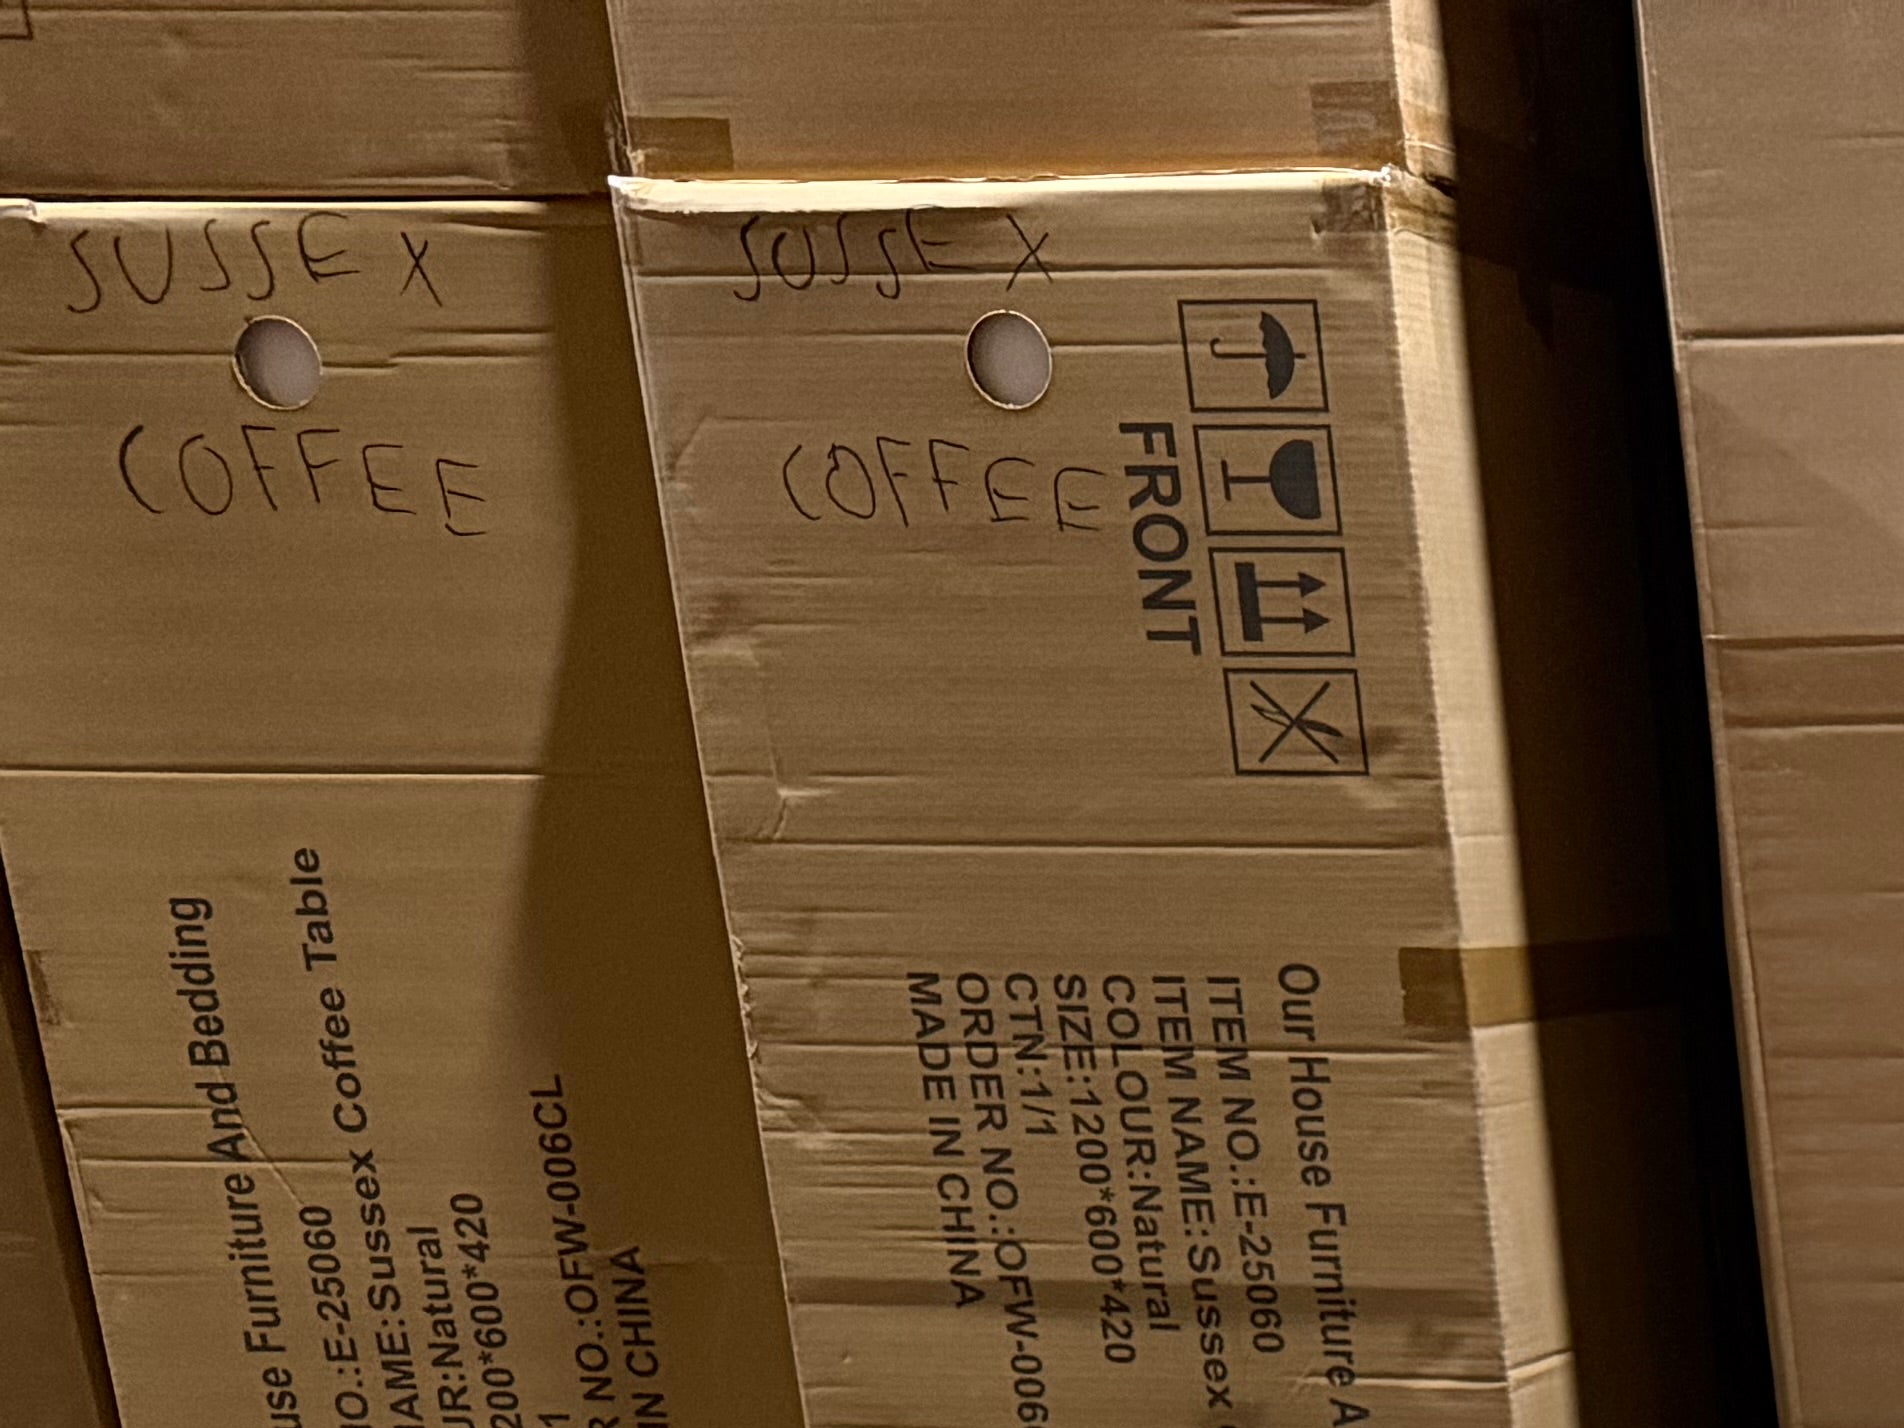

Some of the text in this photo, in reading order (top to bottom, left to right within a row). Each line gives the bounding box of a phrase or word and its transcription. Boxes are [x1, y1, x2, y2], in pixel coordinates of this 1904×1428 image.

[67, 211, 442, 313] SUSSEX
[733, 204, 1053, 301] SUSSEX
[119, 424, 486, 536] COFFEE
[783, 436, 1107, 532] COFFEE
[1117, 421, 1201, 655] FRONT
[169, 896, 230, 1068] Bedding
[289, 848, 338, 972] Table
[317, 987, 369, 1134] Coffee
[955, 972, 1009, 1132] ORDER
[1004, 972, 1057, 1135] CTN:1/1
[1152, 976, 1196, 1082] ITEM
[1277, 961, 1320, 1043] Our
[196, 1081, 250, 1163] And
[907, 971, 986, 1309] MADE IN CHINA
[1101, 975, 1180, 1333] COLOUR:Natural
[1206, 976, 1285, 1354] ITEM NO.:E-25060
[1289, 1057, 1331, 1188] House
[225, 1173, 286, 1355] Furniture
[531, 1073, 613, 1402] NO.:OFW-006CL
[610, 1246, 659, 1377] CHINA
[1169, 1097, 1233, 1410] NAME:Sussex
[1304, 1202, 1357, 1388] Furniture
